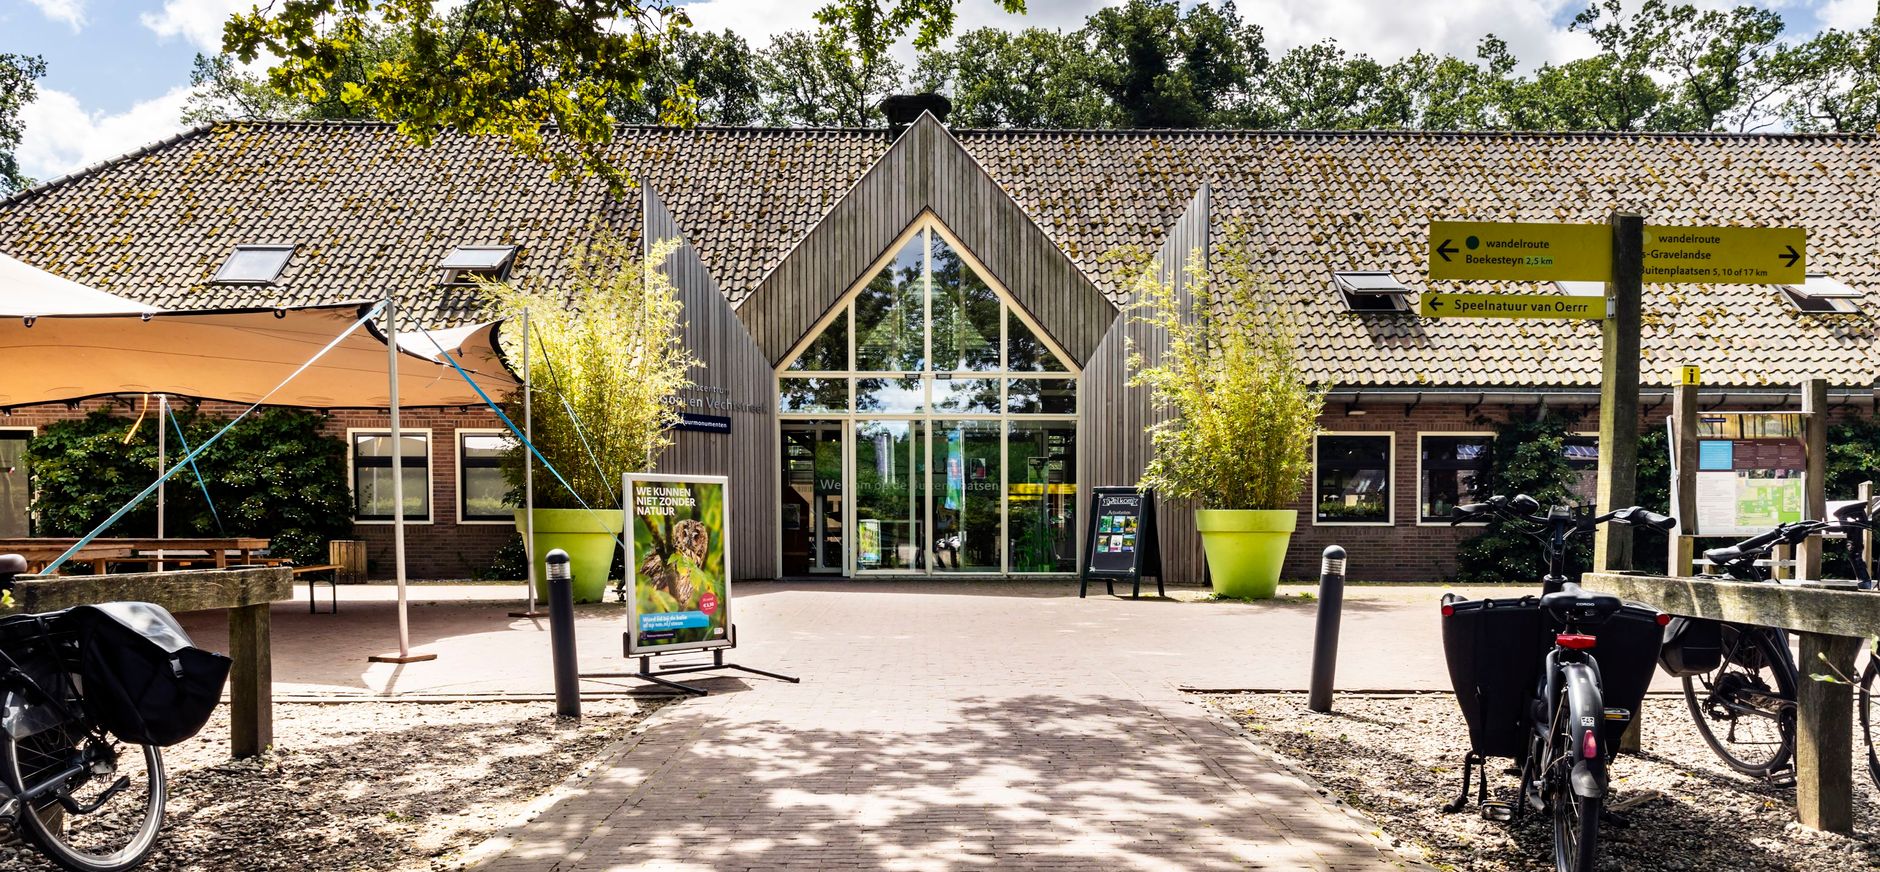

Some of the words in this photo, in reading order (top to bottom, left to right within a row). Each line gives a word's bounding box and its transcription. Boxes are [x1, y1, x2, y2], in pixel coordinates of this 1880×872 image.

[1486, 238, 1550, 249] wandelroute
[1658, 234, 1721, 244] wandelroute
[1465, 254, 1524, 267] Boekesteyn
[1526, 257, 1539, 266] 2,5
[1541, 257, 1553, 265] km
[1712, 268, 1721, 277] 5,
[1722, 268, 1733, 276] 10
[1734, 268, 1743, 277] of
[1744, 268, 1754, 277] 17
[1755, 269, 1768, 277] km
[1454, 299, 1528, 312] Speelnatuur
[1531, 302, 1551, 312] van
[1554, 301, 1589, 313] Oerrr
[689, 398, 703, 408] en
[636, 486, 652, 496] WE
[653, 487, 691, 497] KUNNEN
[636, 496, 658, 506] NIET
[659, 497, 696, 507] ZONDER
[636, 506, 675, 516] NATUUR
